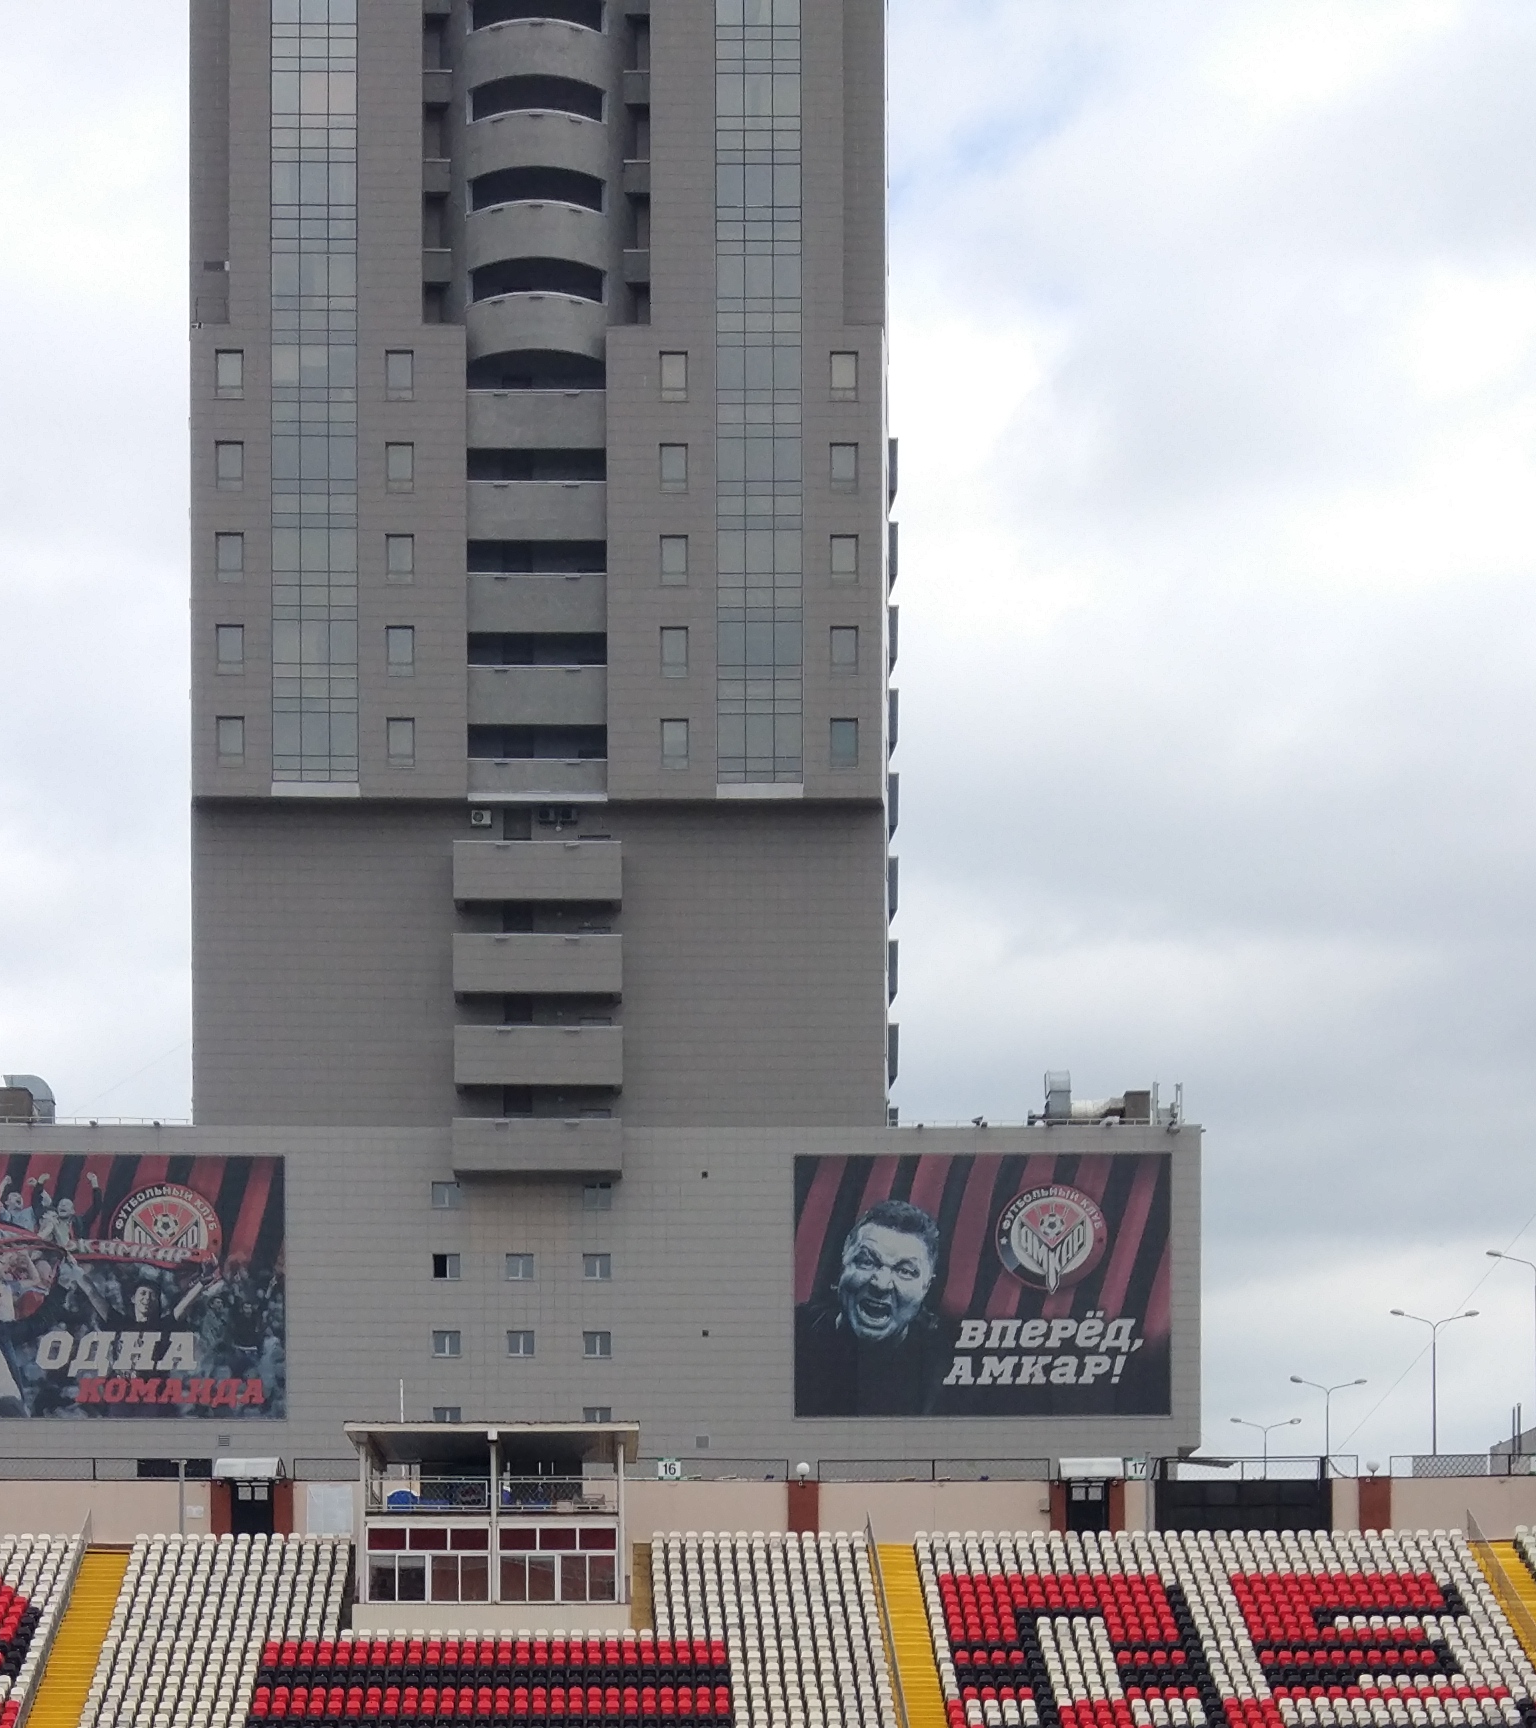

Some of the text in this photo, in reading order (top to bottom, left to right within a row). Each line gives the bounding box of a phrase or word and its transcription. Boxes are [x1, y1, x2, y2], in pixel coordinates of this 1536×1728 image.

[115, 1186, 217, 1231] ФУТБОЛЬНЫЙ КЛУБ
[1002, 1187, 1104, 1230] ФУТБОЛЬНЫЙ КЛУБ
[35, 1331, 199, 1378] ОДНА
[74, 1378, 265, 1408] КОМАНДА
[663, 1463, 676, 1475] 16
[1132, 1462, 1146, 1475] 17
